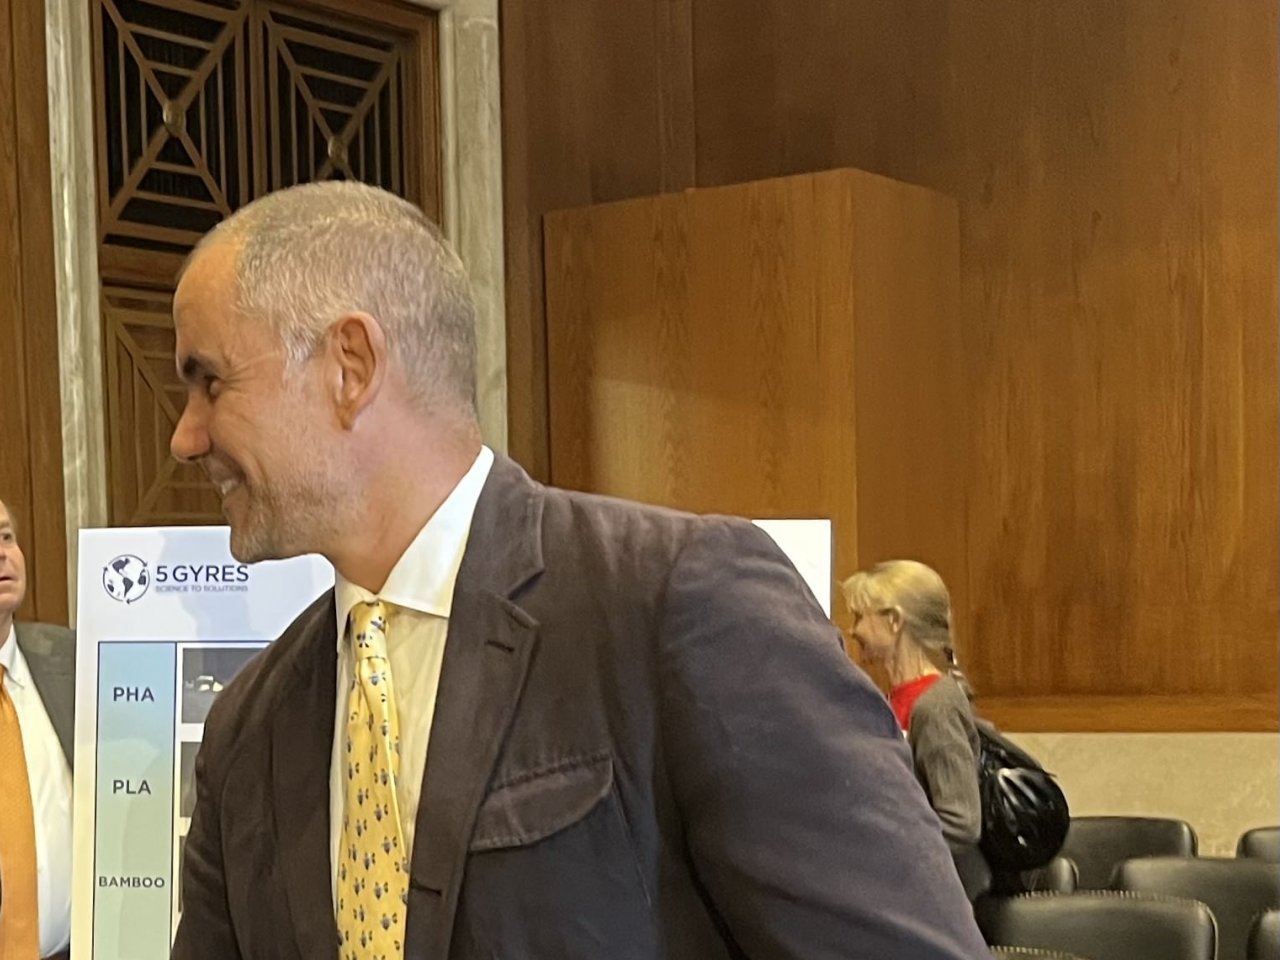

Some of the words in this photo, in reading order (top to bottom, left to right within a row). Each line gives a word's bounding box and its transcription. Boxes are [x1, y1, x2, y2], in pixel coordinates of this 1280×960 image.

[156, 565, 168, 582] 5
[172, 565, 249, 582] GYRES
[113, 687, 155, 702] PHA
[113, 779, 151, 795] PLA
[98, 876, 165, 889] BAMBOO
